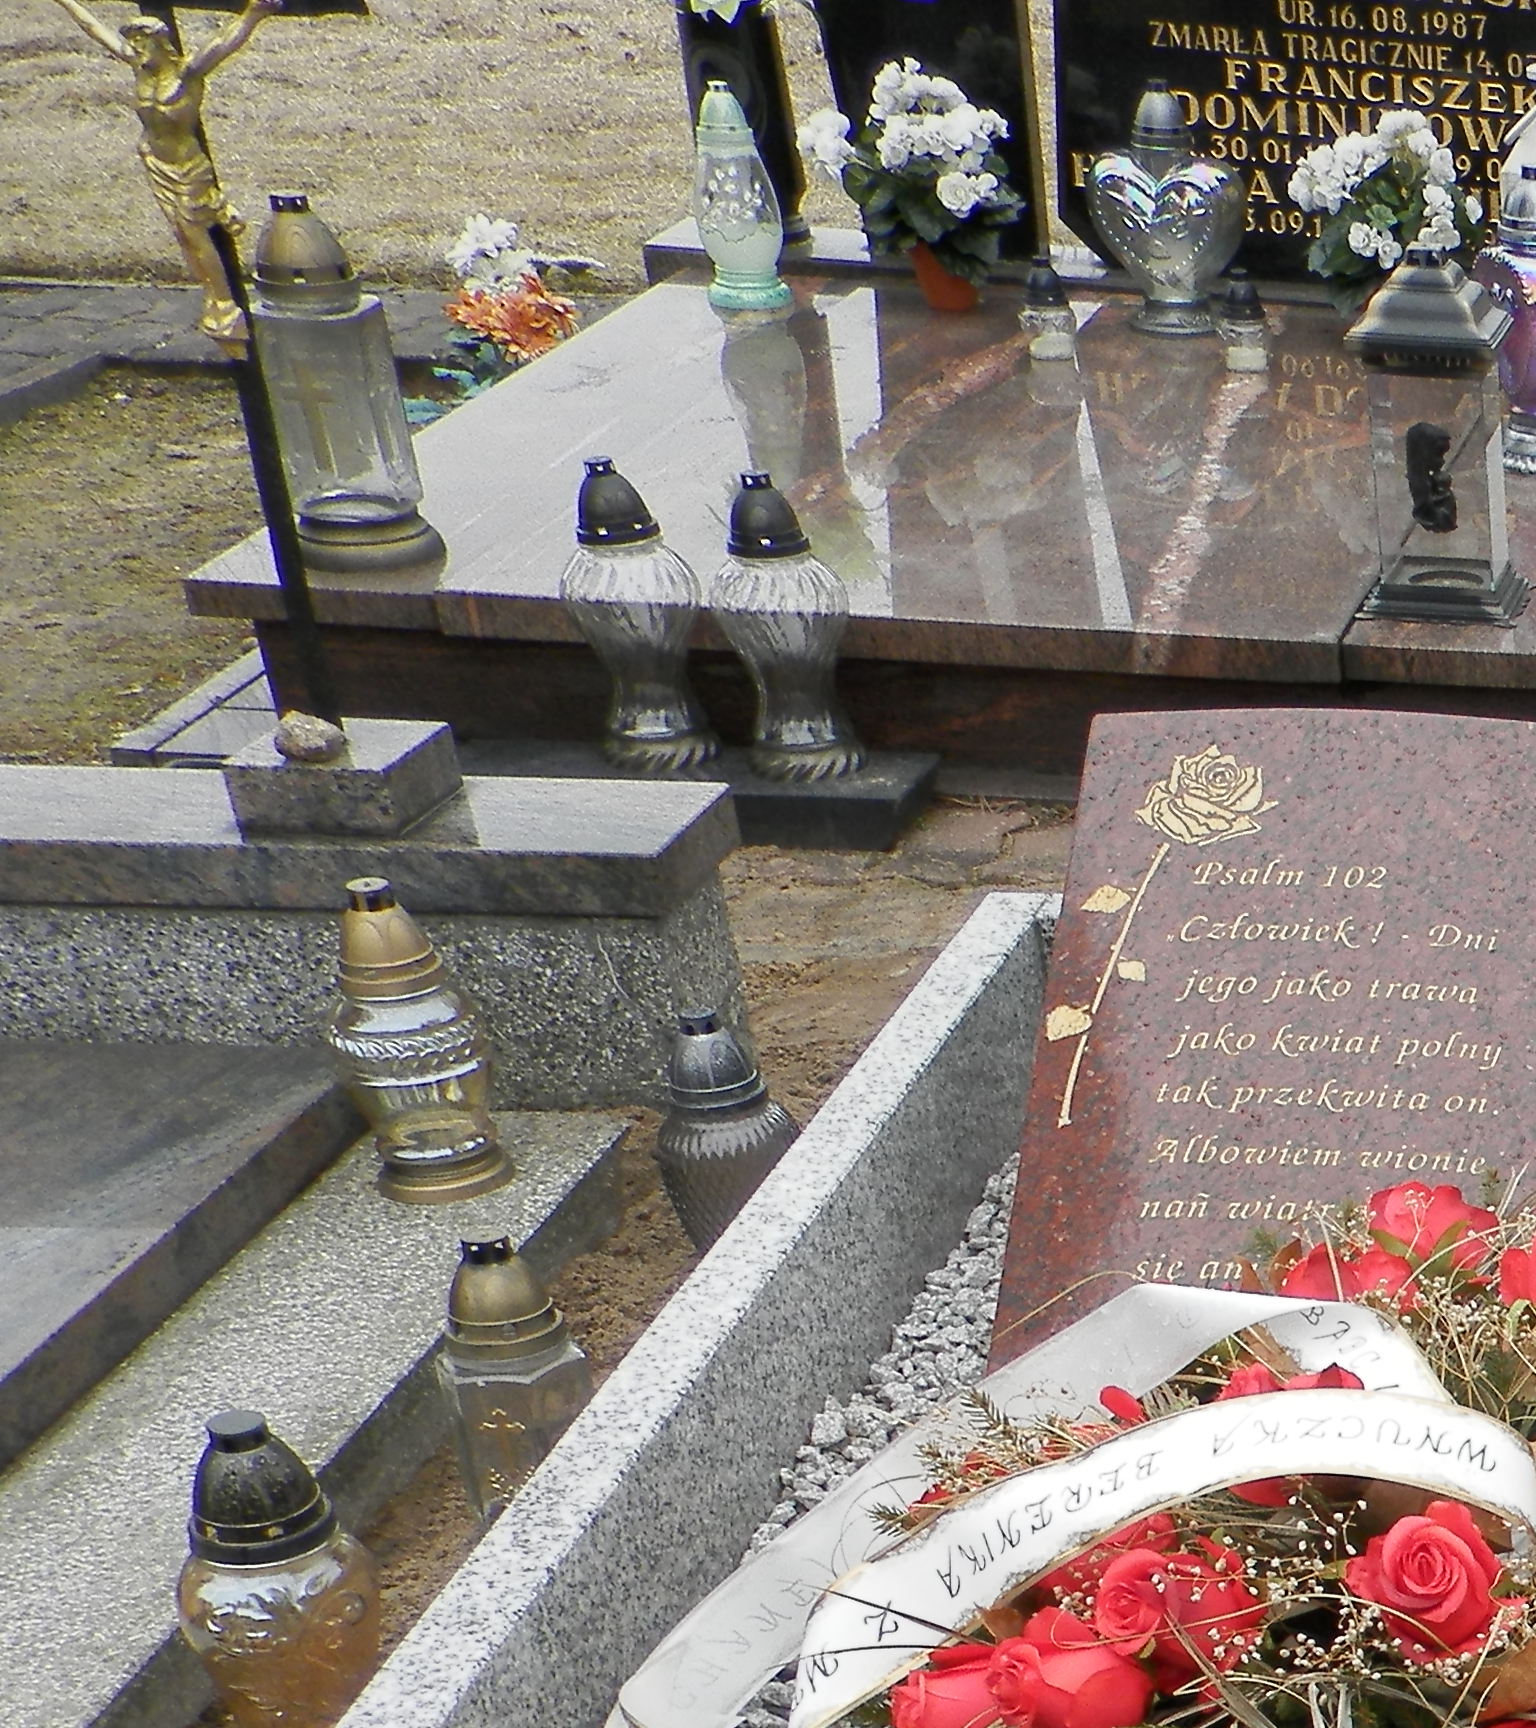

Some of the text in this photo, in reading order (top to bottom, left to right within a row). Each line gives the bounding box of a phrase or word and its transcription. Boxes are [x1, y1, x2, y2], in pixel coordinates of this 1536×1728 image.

[1149, 21, 1270, 56] ZMARŁA
[1282, 32, 1453, 72] TRAGICZNIE
[1193, 860, 1389, 890] Psalm 102
[1428, 923, 1501, 951] Dni
[1175, 969, 1479, 1004] jego jako trawa
[1167, 1022, 1504, 1071] jako kwiat polny
[1156, 1078, 1500, 1116] tak przekwita on.
[1147, 1134, 1488, 1175] Albowiem wionie
[1133, 1253, 1184, 1281] się
[935, 1449, 1167, 1599] BERENIKA
